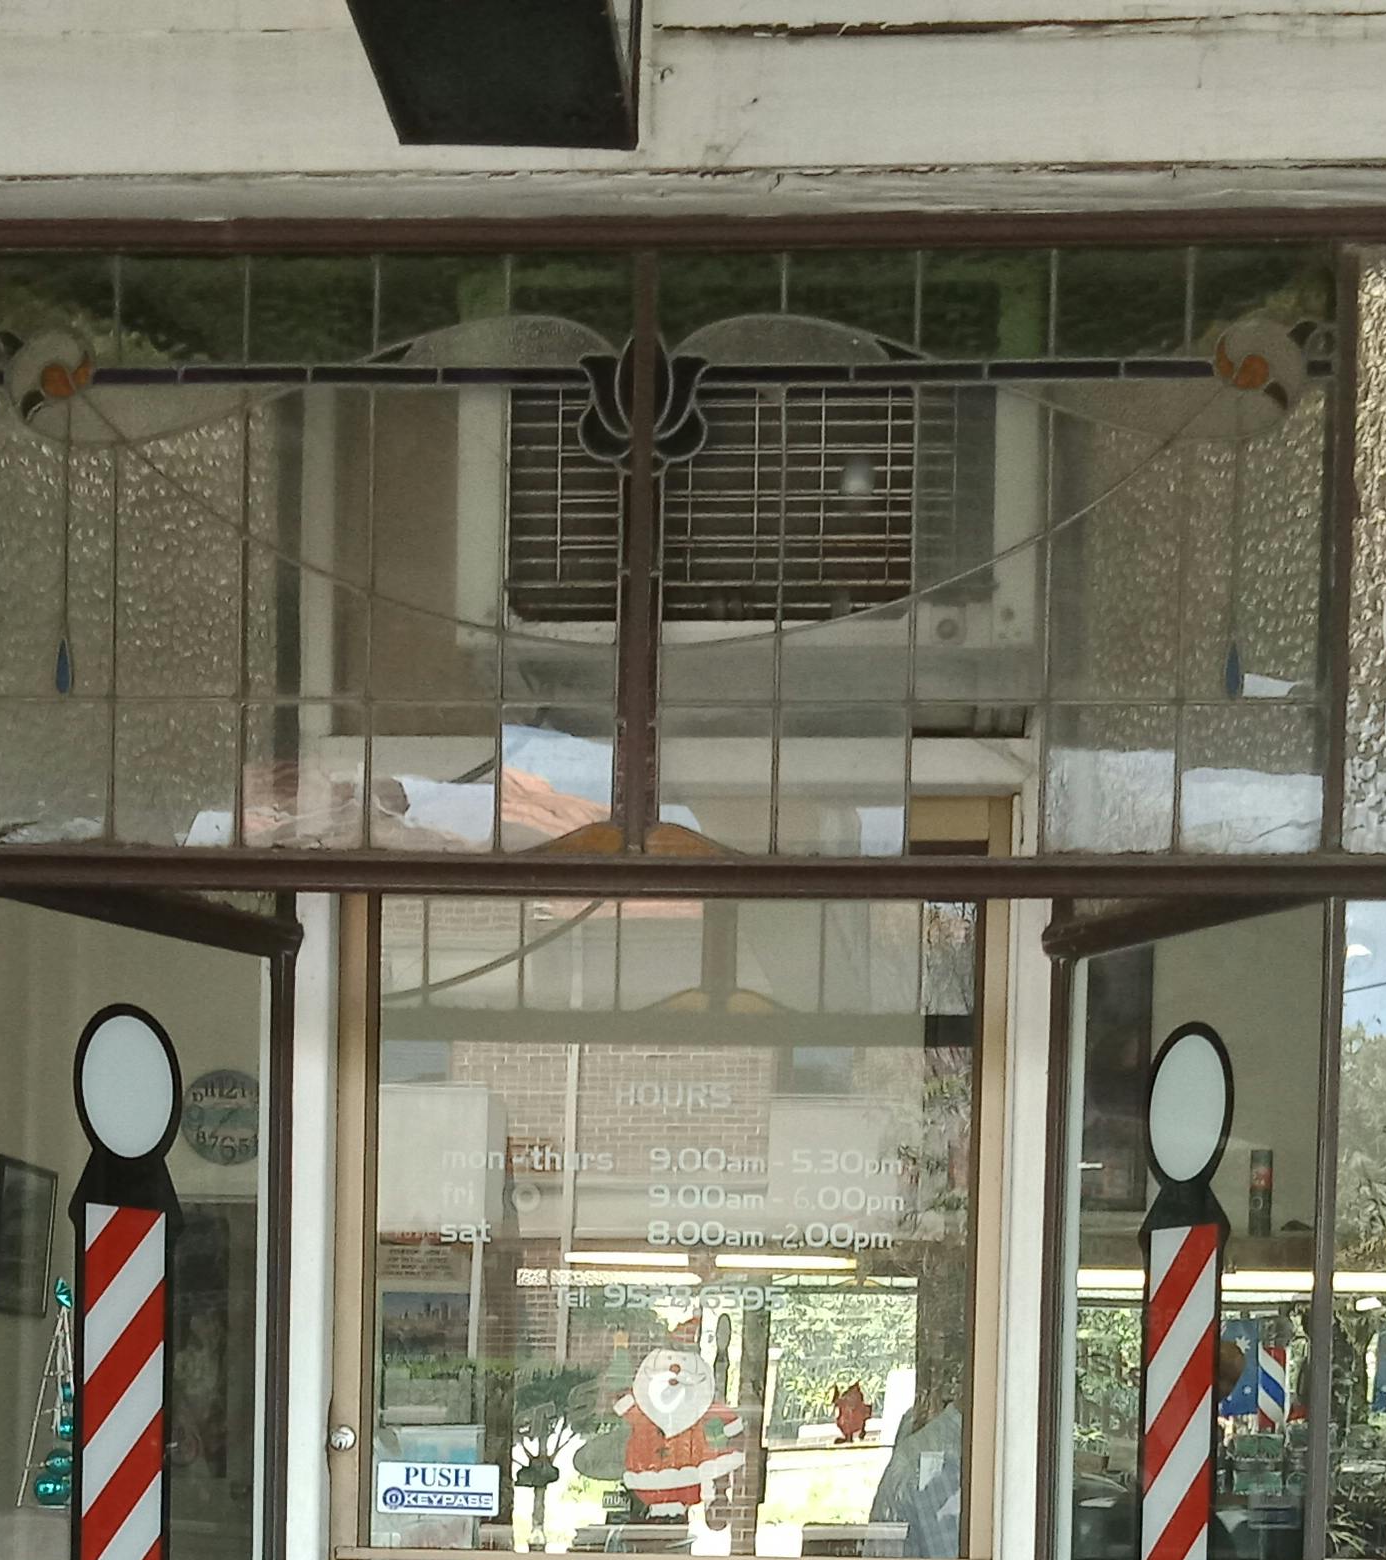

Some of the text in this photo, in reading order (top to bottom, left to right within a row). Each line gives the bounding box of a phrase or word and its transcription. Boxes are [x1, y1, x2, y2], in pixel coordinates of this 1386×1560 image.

[616, 1081, 734, 1108] HOURS
[649, 1148, 765, 1173] 9.00am
[792, 1149, 903, 1178] 5.30pm
[648, 1184, 765, 1211] 9.00am
[793, 1186, 904, 1215] 6.00pm
[440, 1218, 492, 1244] sat
[647, 1221, 765, 1247] 8.00am
[551, 1284, 787, 1311] Tel: 9528 6395
[404, 1466, 471, 1487] PUSH
